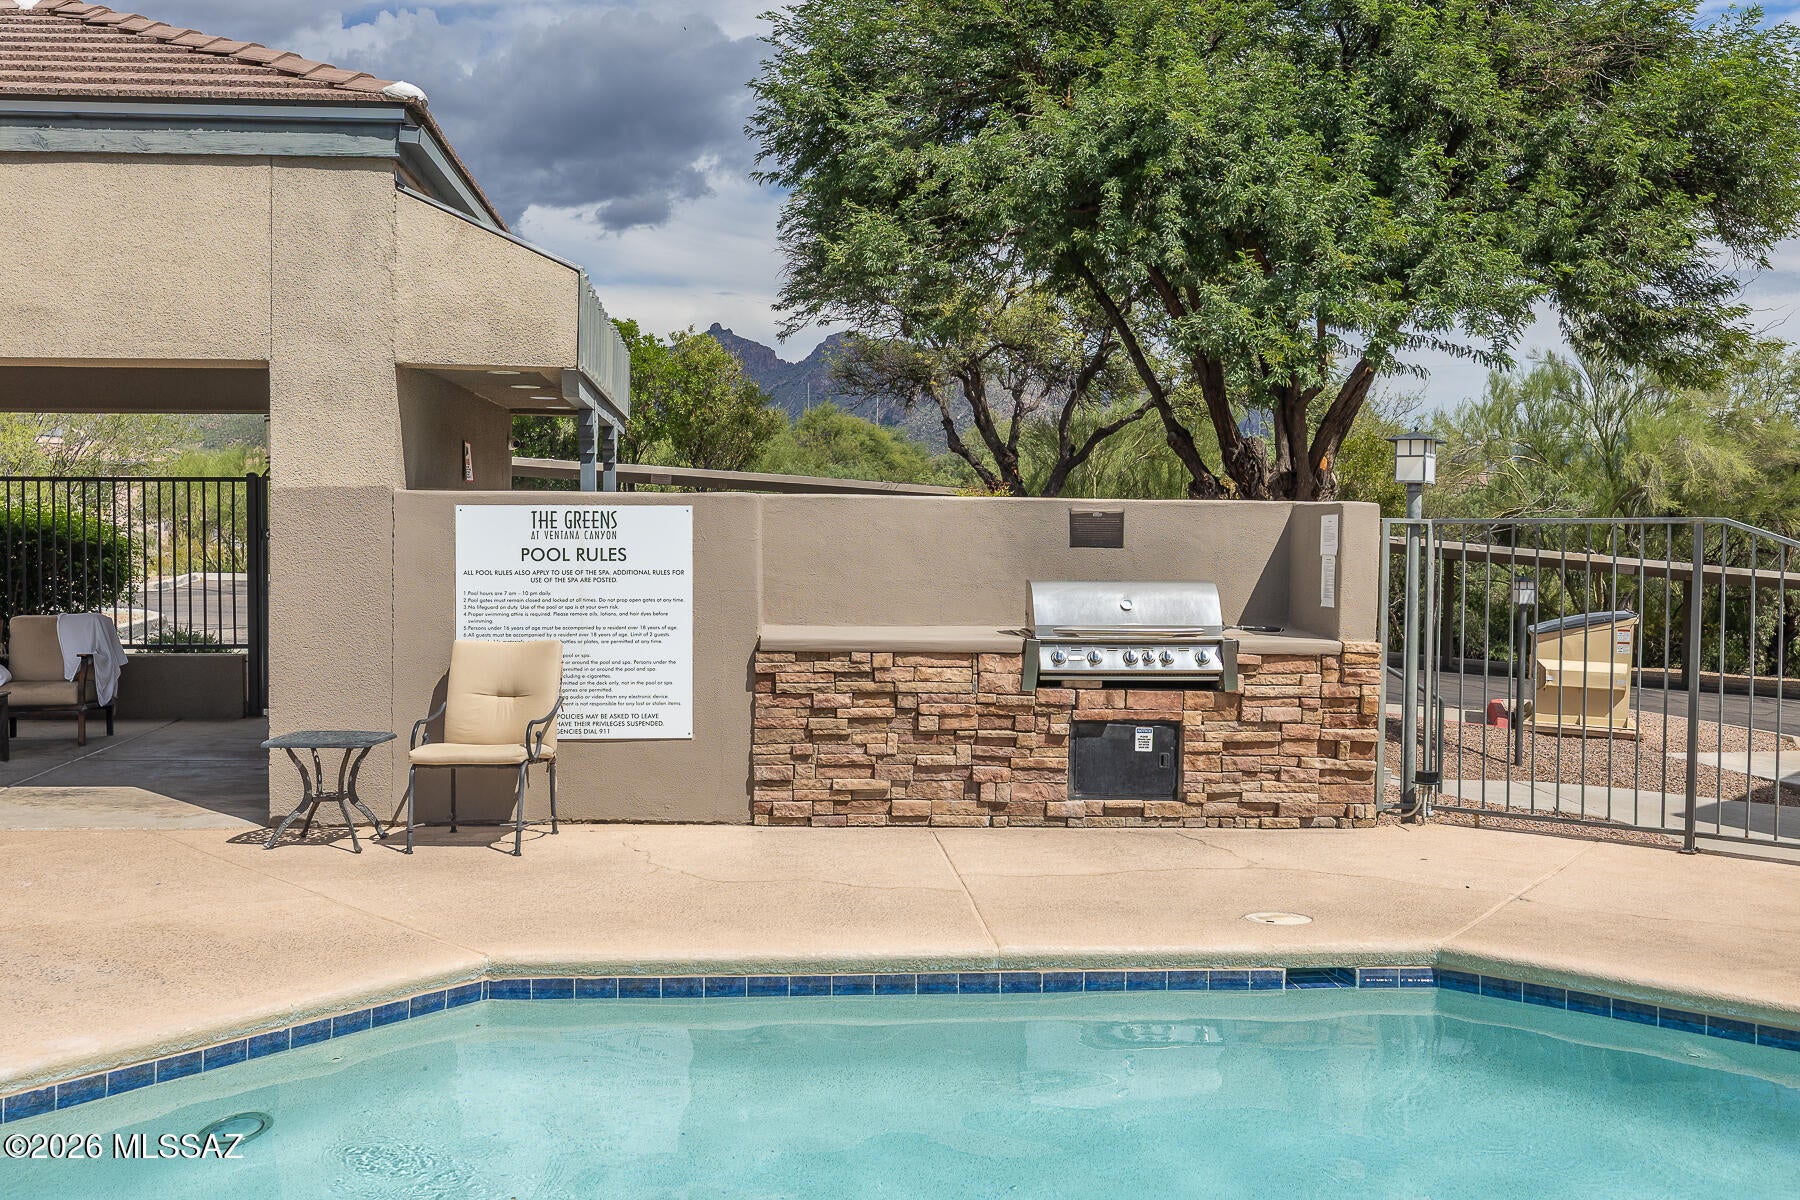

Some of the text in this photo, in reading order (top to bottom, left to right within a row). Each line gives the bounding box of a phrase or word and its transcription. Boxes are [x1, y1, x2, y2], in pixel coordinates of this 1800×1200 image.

[530, 510, 617, 529] THE GREENS
[530, 530, 617, 540] AT VENTANA CANYON
[521, 547, 627, 562] POOL RULES
